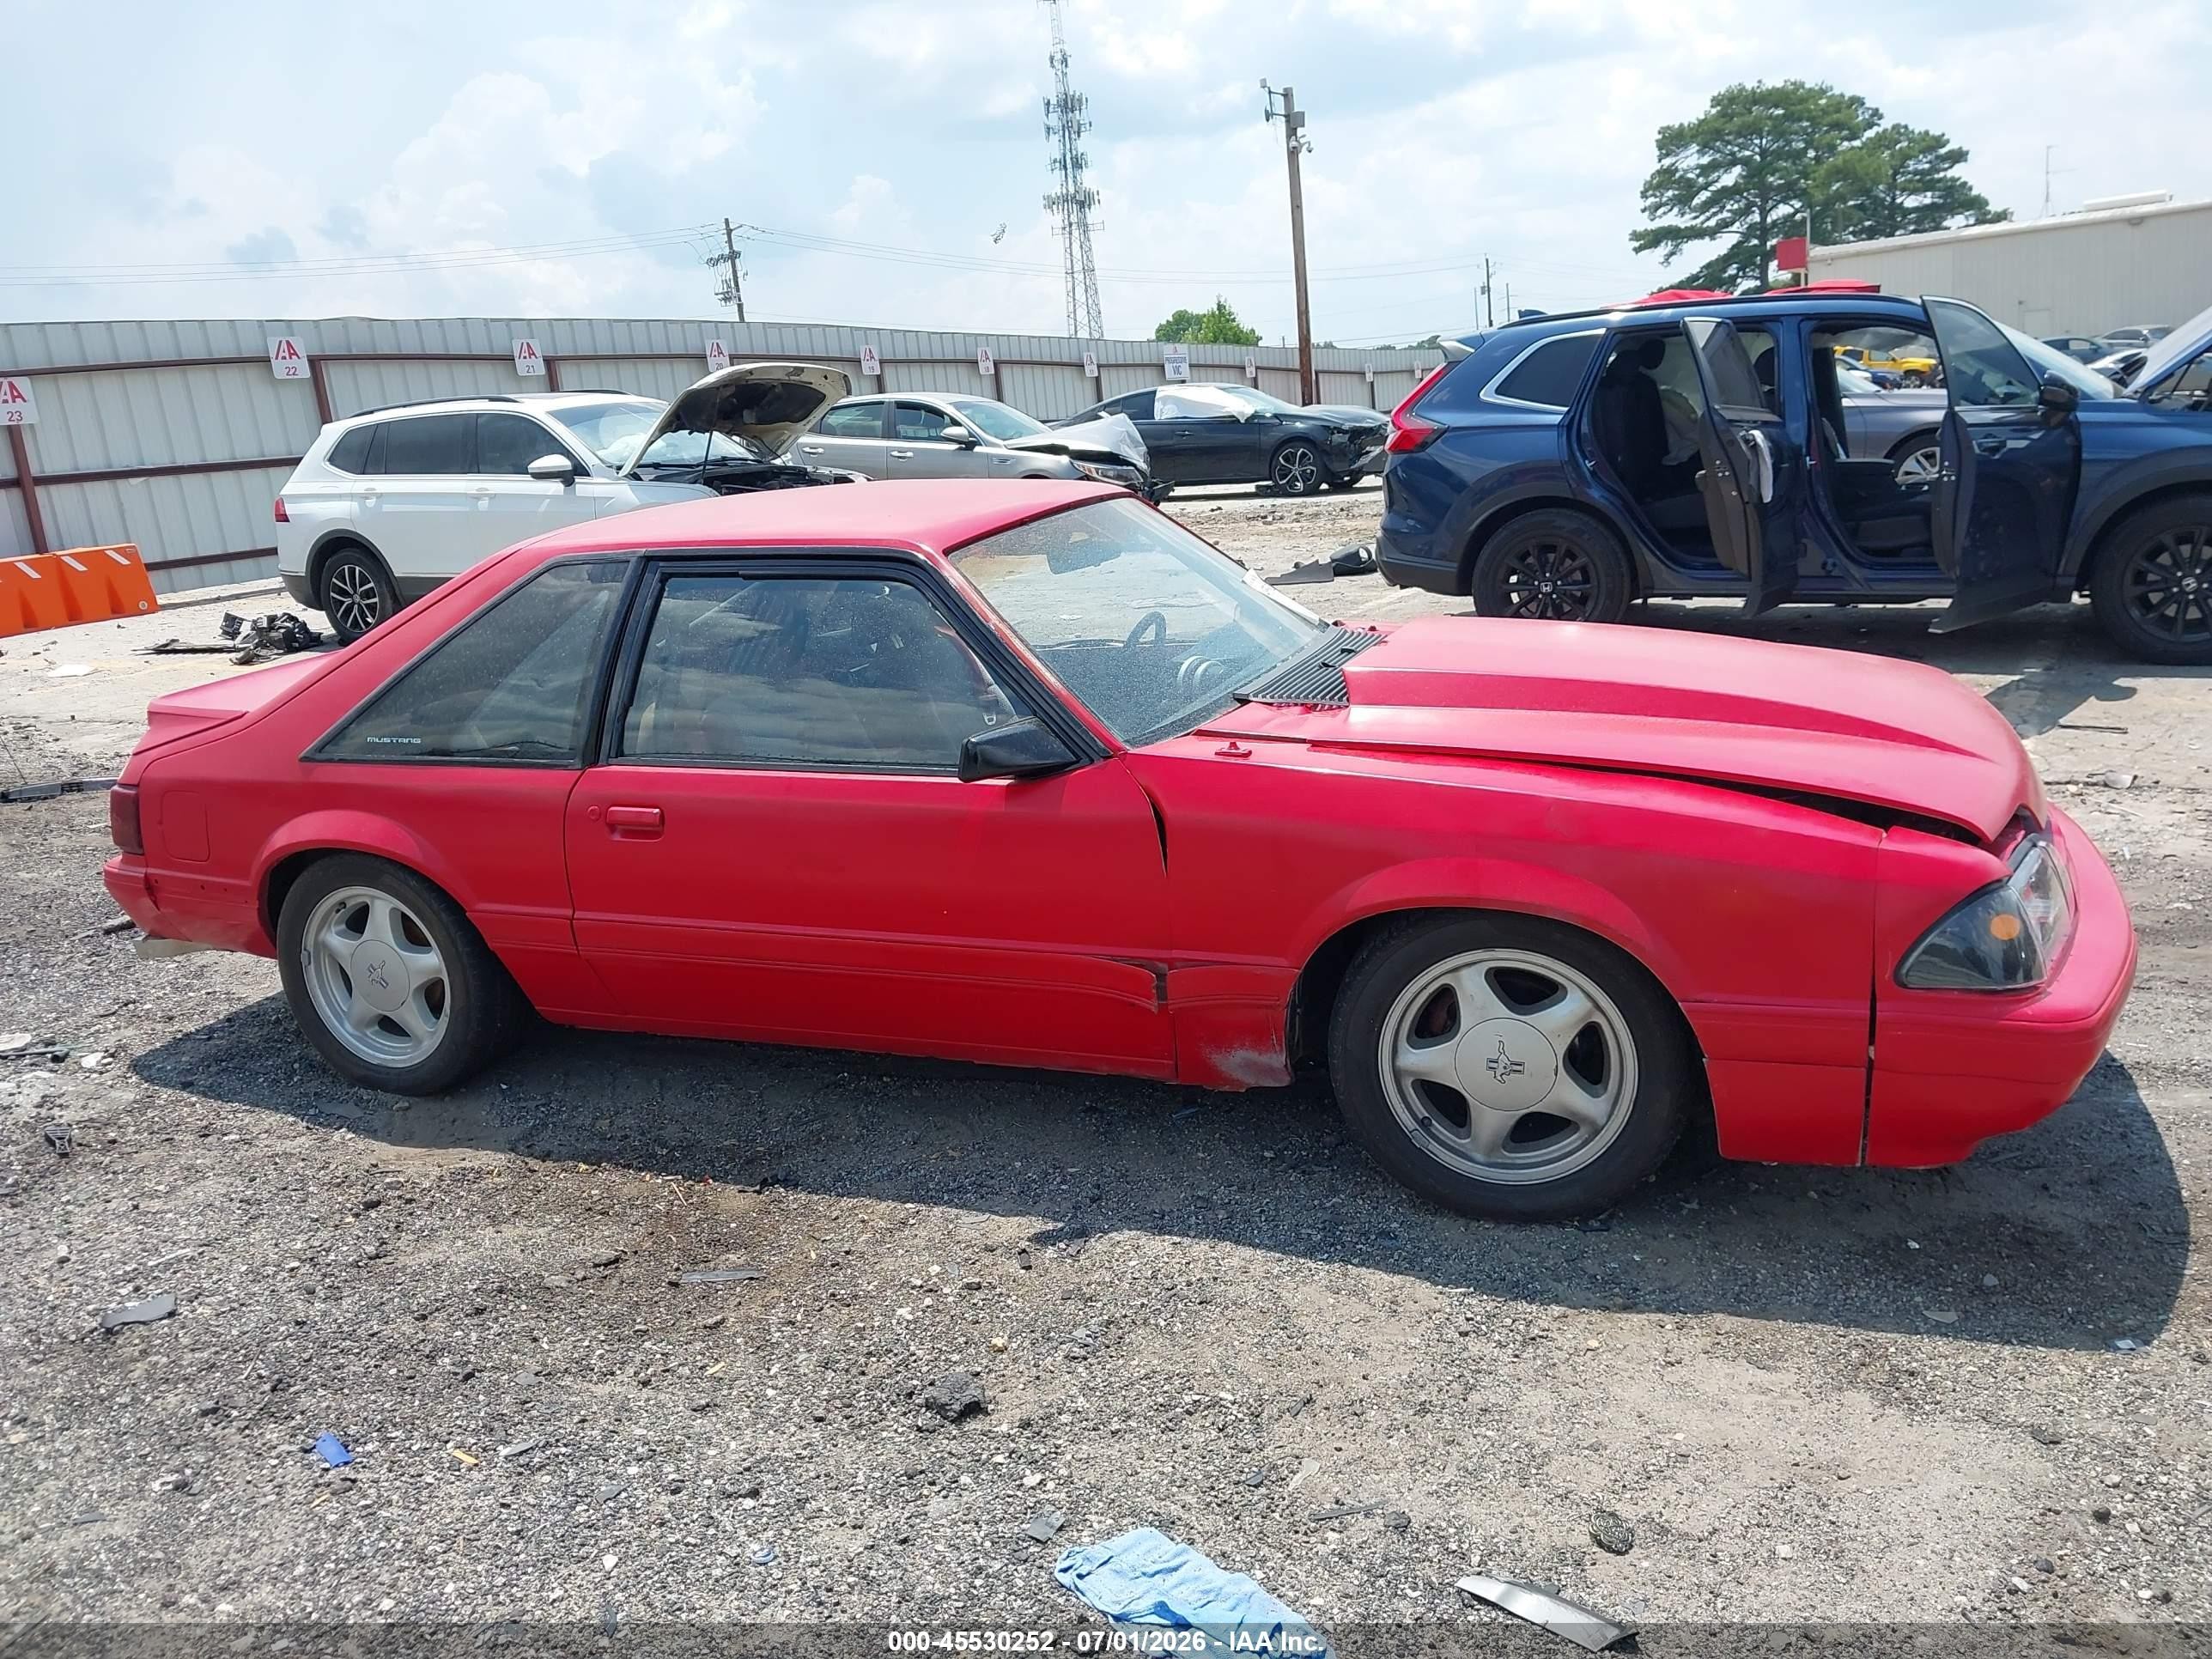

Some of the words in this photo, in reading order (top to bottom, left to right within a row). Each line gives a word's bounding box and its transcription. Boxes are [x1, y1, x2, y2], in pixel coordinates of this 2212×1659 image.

[285, 366, 299, 376] 22
[526, 364, 536, 374] 21
[7, 410, 23, 422] 23
